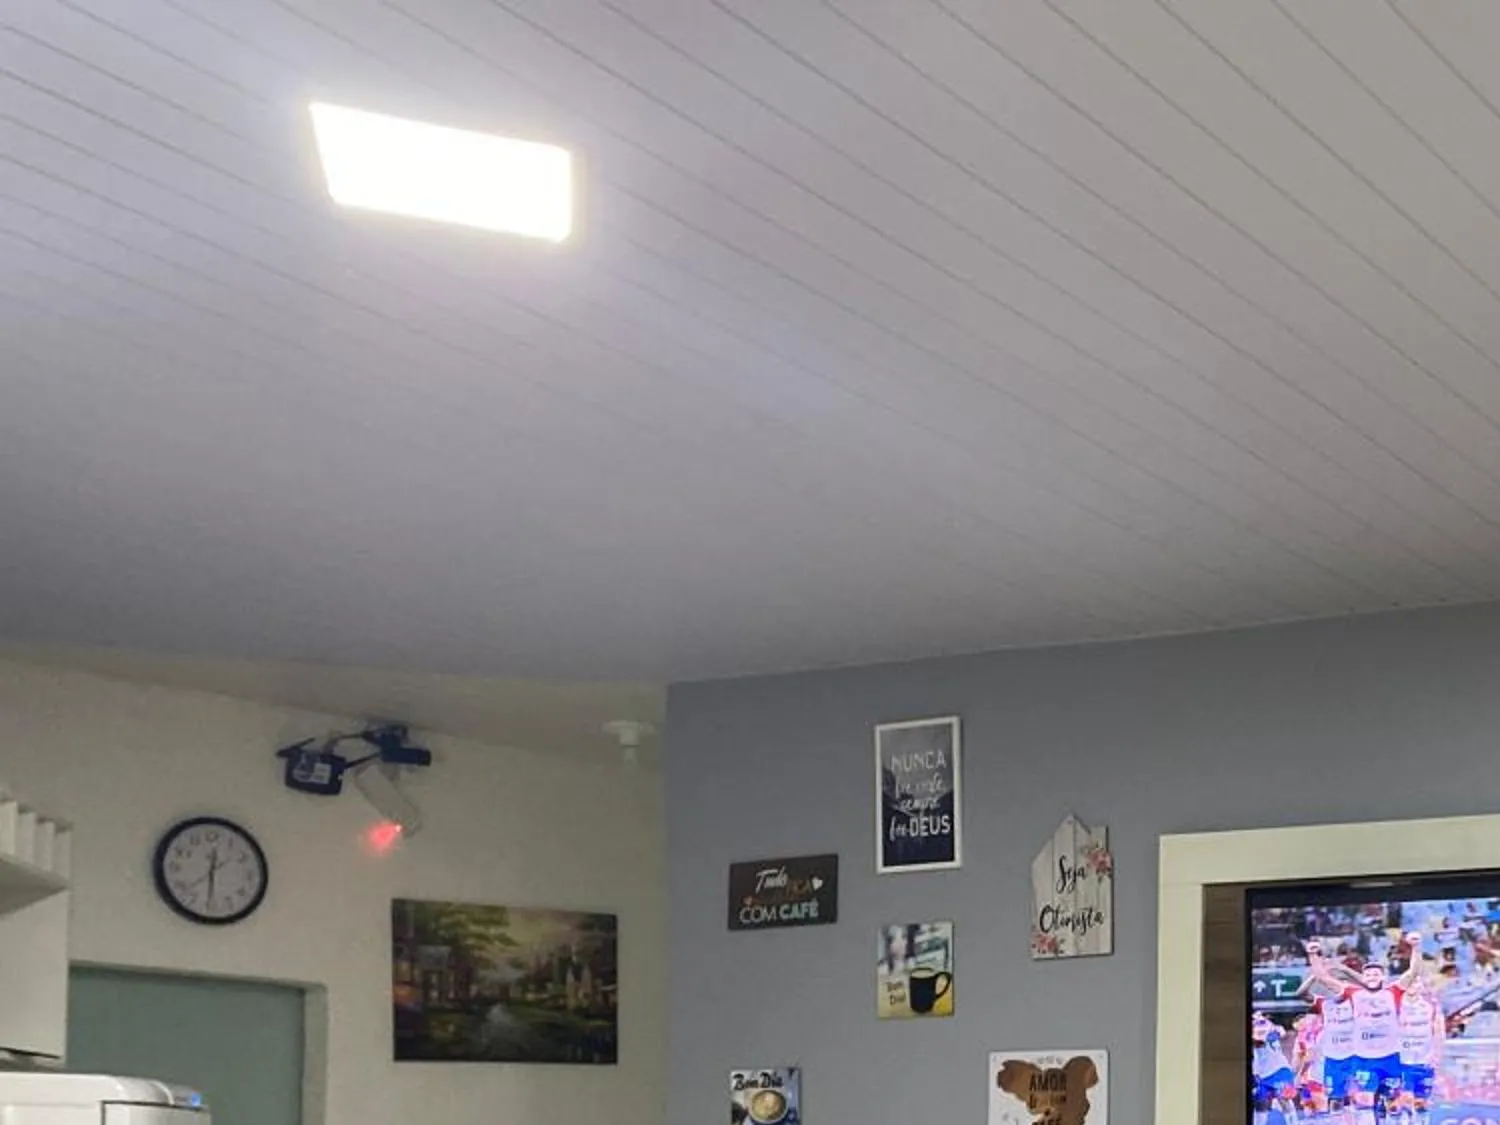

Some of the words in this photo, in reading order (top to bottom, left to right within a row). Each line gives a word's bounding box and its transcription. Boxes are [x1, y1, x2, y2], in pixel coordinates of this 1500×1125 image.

[890, 748, 947, 773] NUNCA
[909, 814, 951, 838] DEUS
[739, 903, 777, 924] COM
[779, 898, 820, 920] CAFÉ
